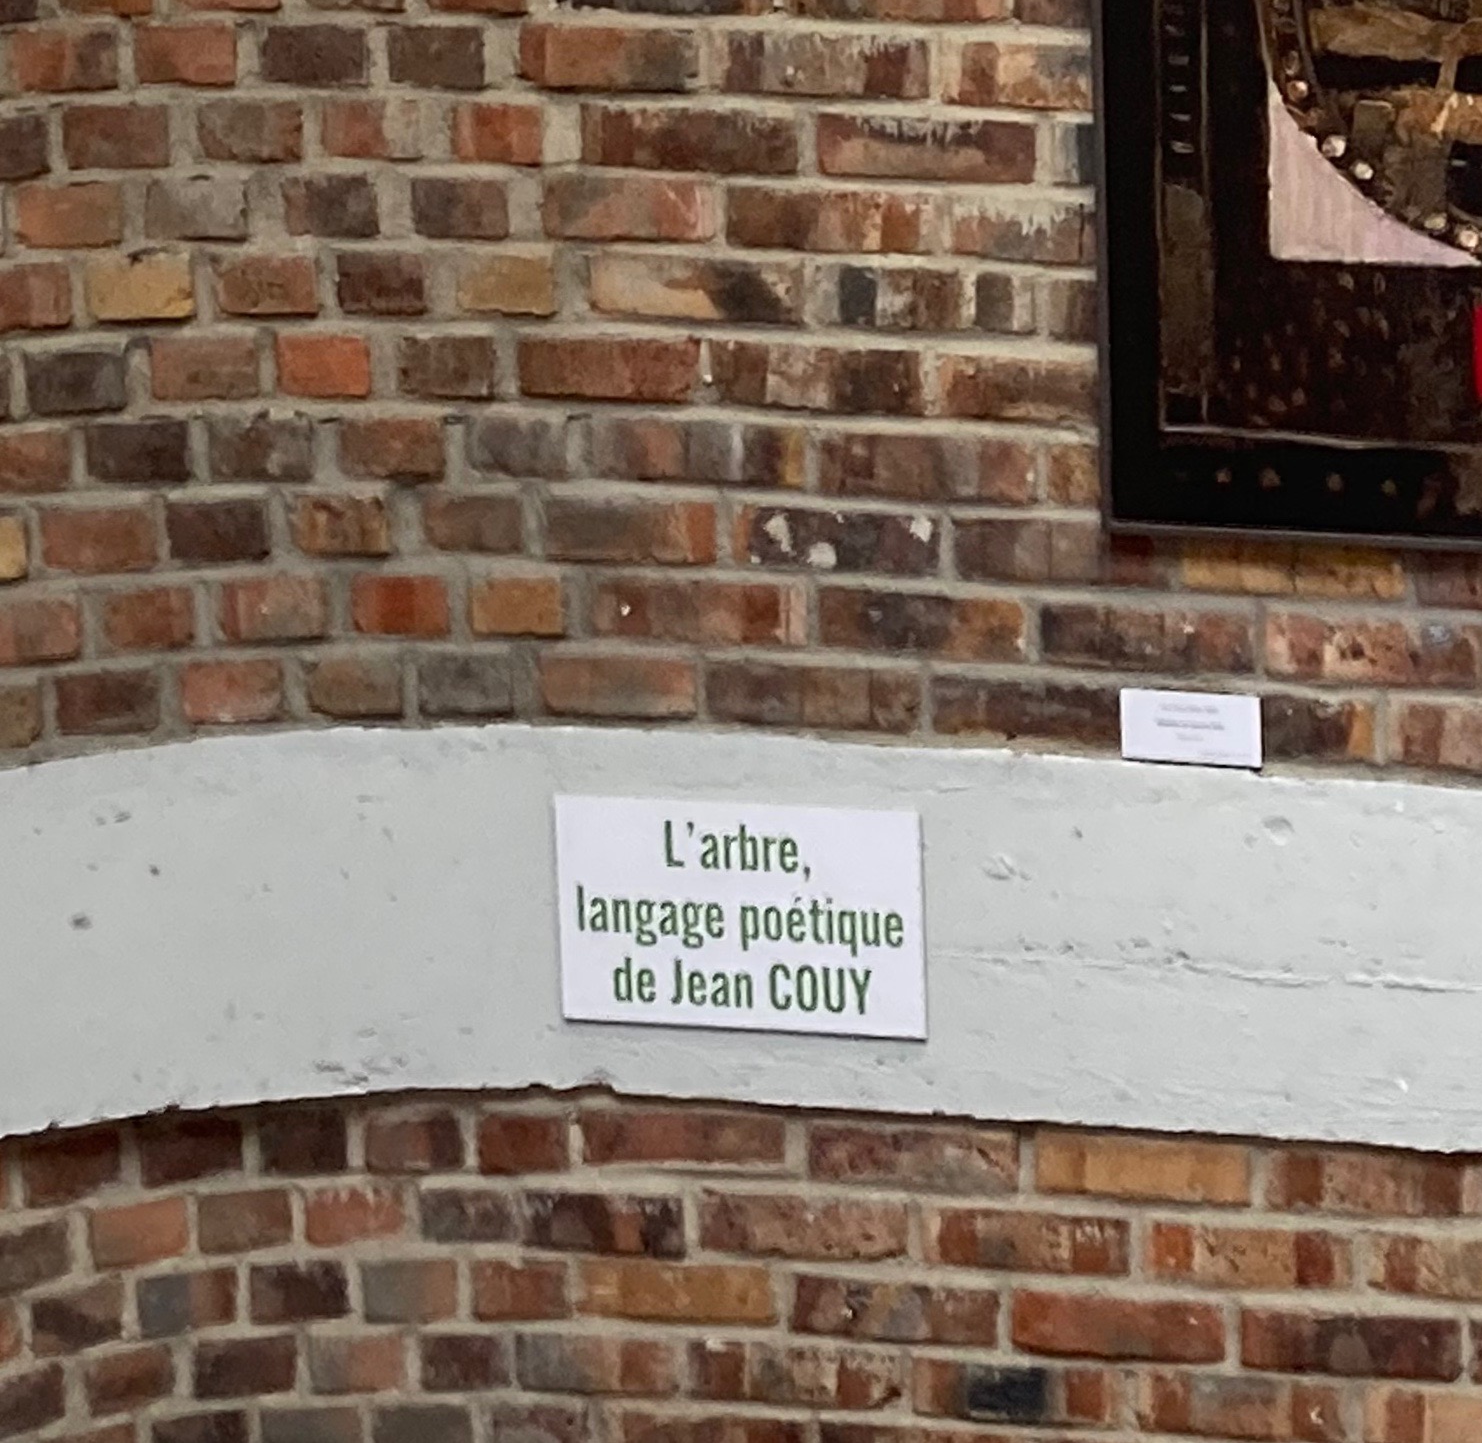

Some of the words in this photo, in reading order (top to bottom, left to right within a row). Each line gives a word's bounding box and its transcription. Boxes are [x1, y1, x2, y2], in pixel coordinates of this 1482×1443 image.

[664, 819, 811, 882] L'arbre,
[576, 884, 725, 949] langage
[739, 896, 904, 957] poétique
[612, 956, 657, 1003] de
[670, 958, 753, 1009] Jean
[768, 962, 872, 1015] COUY
